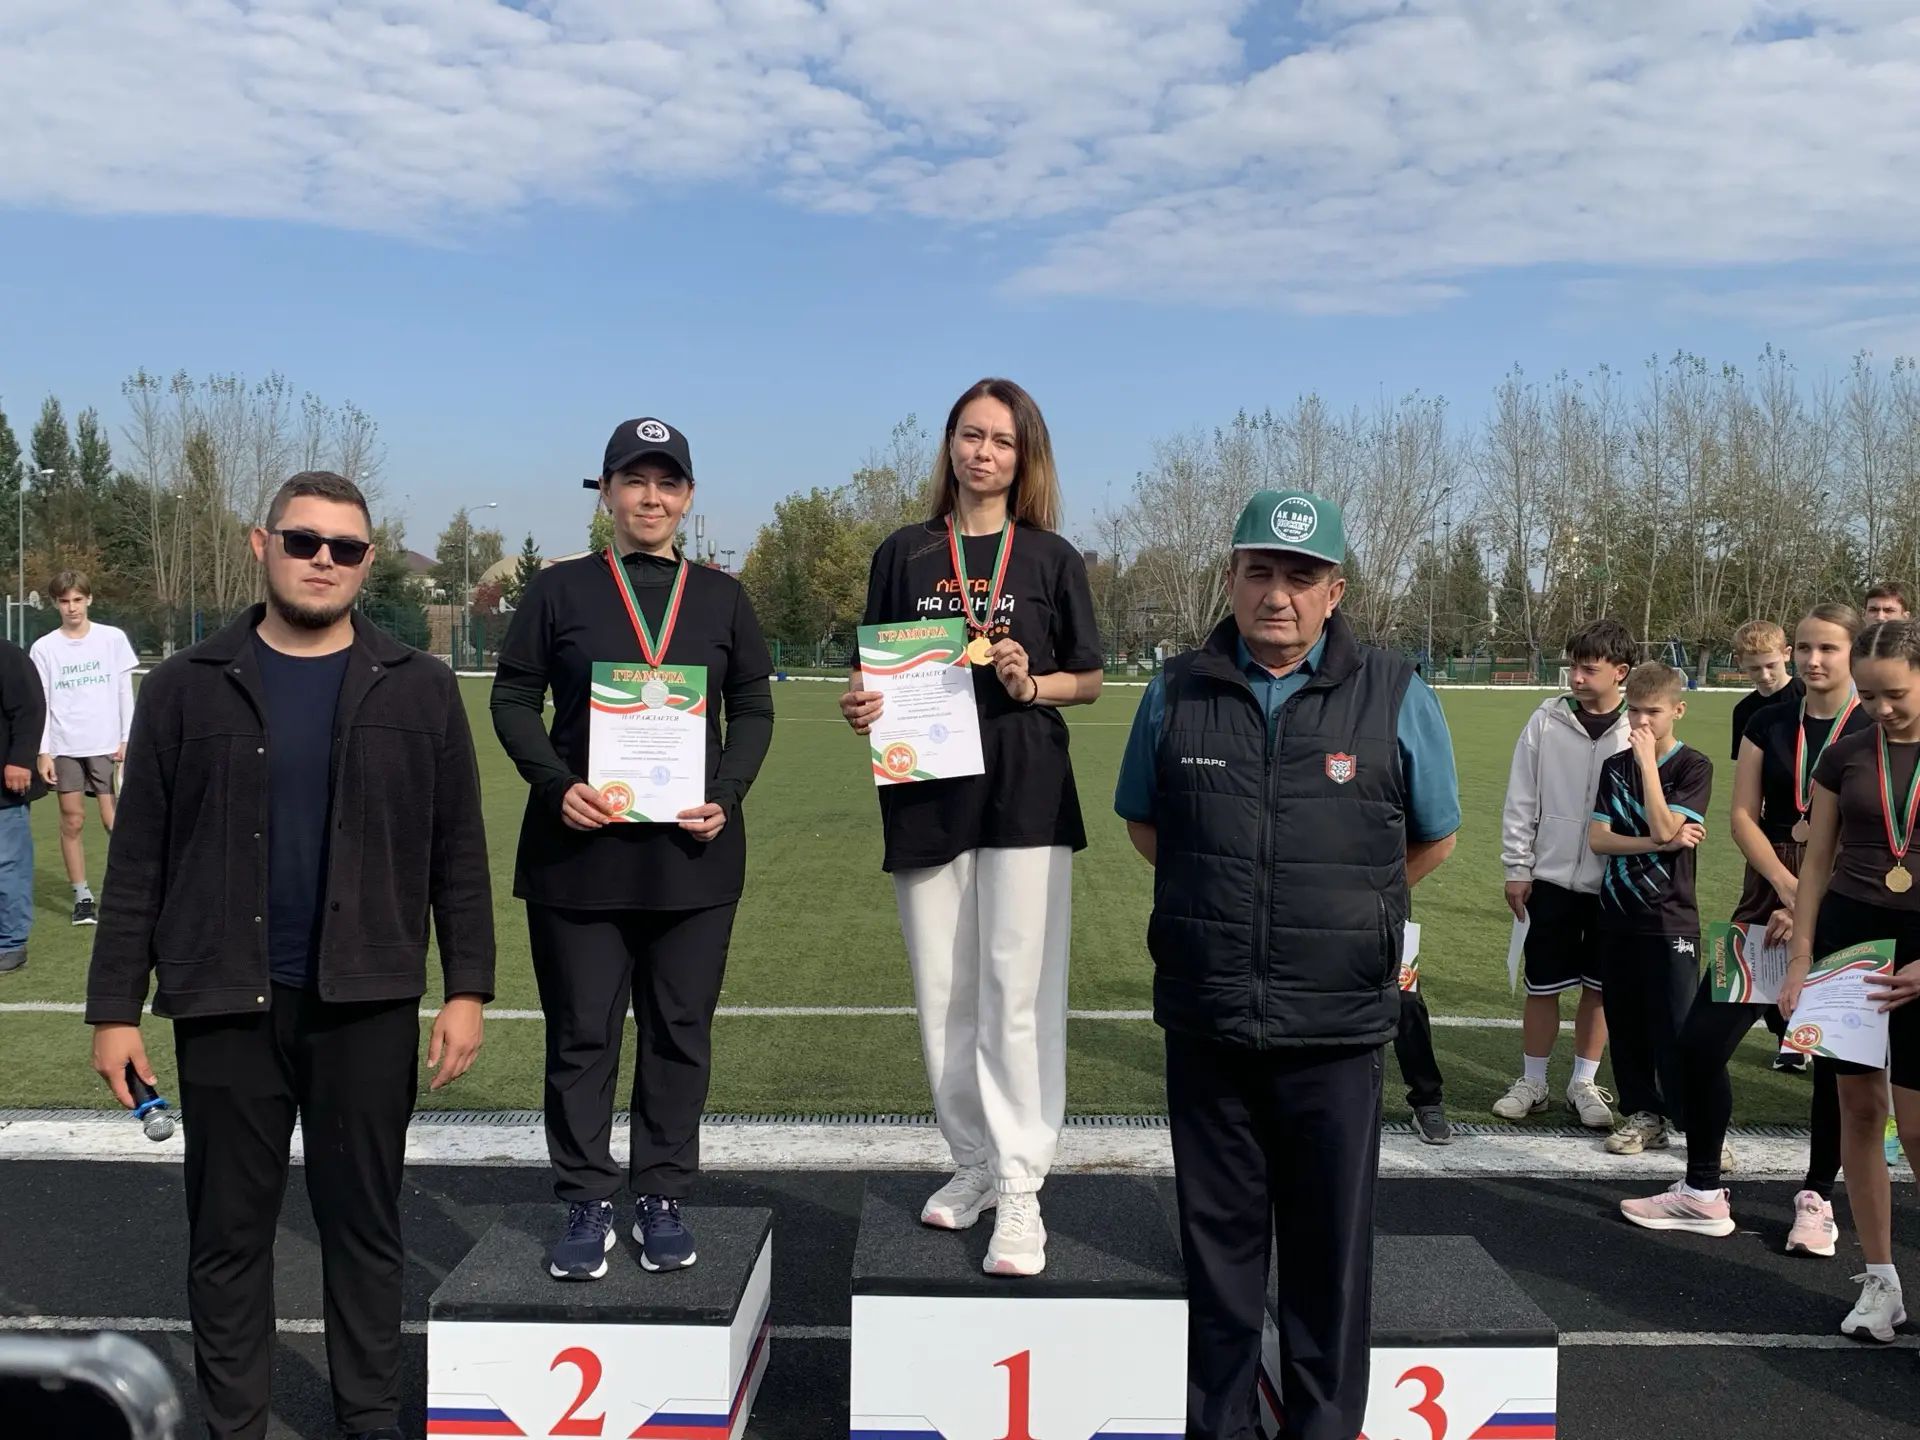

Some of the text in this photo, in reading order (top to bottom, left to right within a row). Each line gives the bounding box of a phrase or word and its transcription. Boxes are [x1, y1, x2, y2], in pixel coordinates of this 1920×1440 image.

[1277, 510, 1313, 524] AK BARS
[916, 596, 943, 612] НА
[55, 675, 111, 690] ИНТЕРНАТ
[1196, 757, 1226, 767] БАРС
[547, 1347, 606, 1437] 2
[993, 1349, 1039, 1440] 1
[1394, 1365, 1448, 1440] 3
